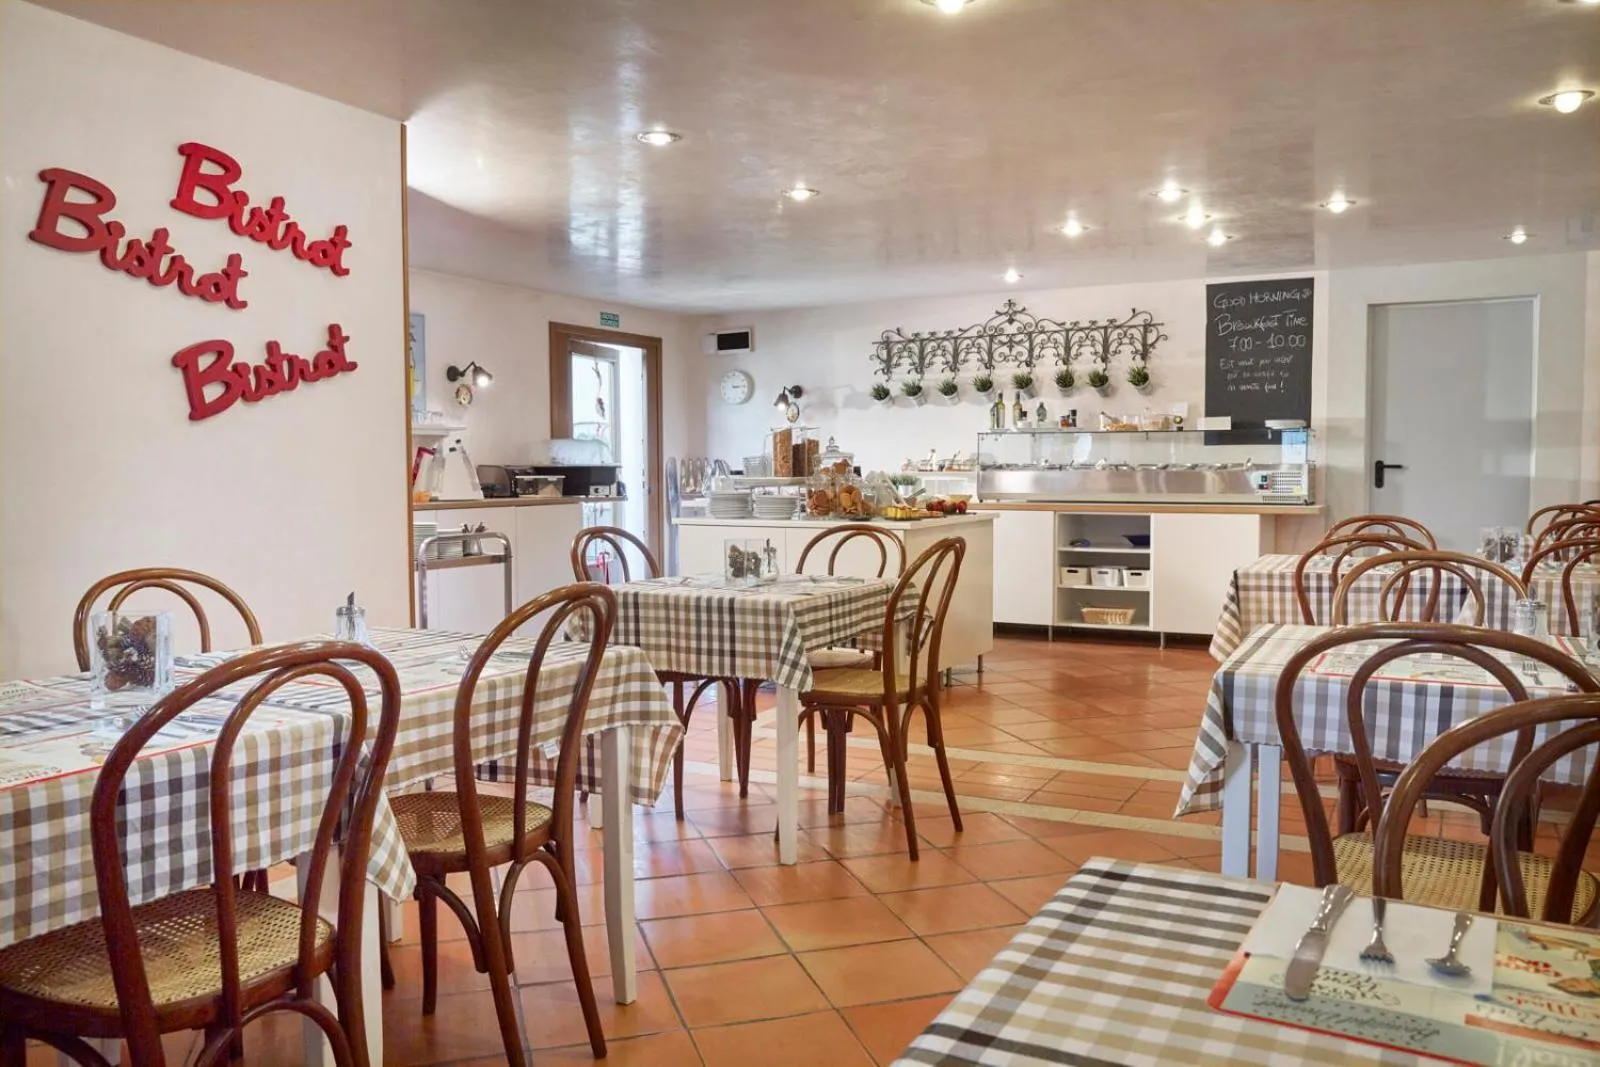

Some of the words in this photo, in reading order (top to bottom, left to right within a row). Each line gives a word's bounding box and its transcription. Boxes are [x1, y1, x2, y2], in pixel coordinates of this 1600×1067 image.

[29, 168, 248, 309] Bistrot
[170, 142, 352, 276] Bistrot
[171, 323, 357, 421] Bistrot
